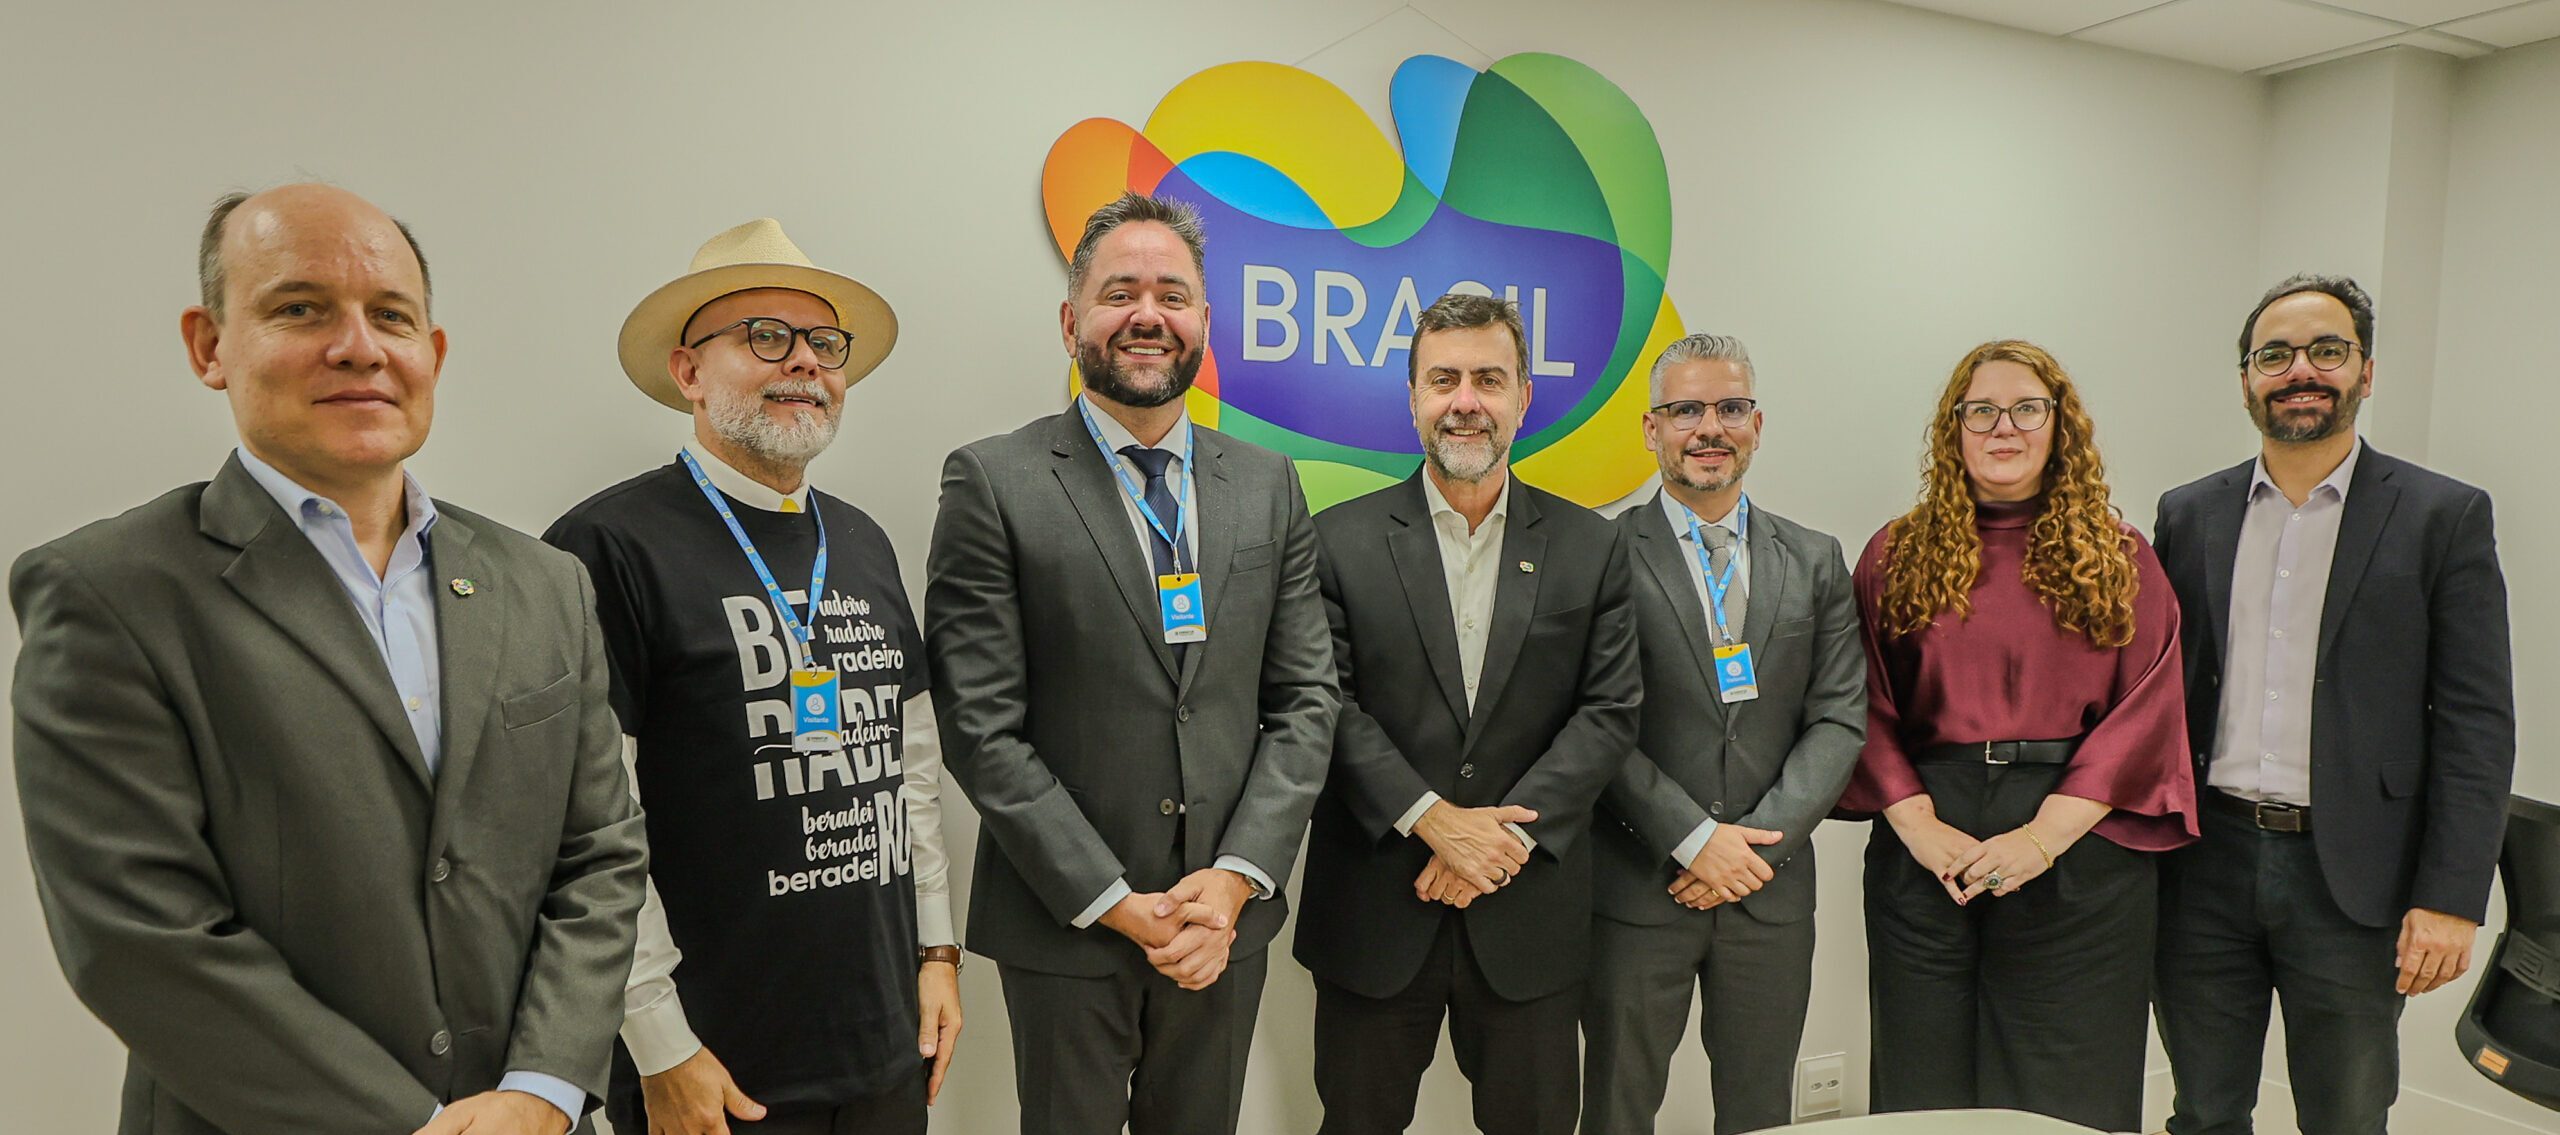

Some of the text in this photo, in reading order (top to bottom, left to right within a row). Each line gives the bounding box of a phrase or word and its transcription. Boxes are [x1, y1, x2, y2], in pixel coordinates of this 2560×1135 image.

[1242, 264, 1575, 377] BRAL
[824, 619, 885, 644] radeiro
[831, 643, 904, 673] radeiro
[802, 797, 874, 835] beradei
[874, 784, 911, 886] RO
[805, 826, 877, 862] beradei
[768, 851, 878, 896] beradei
